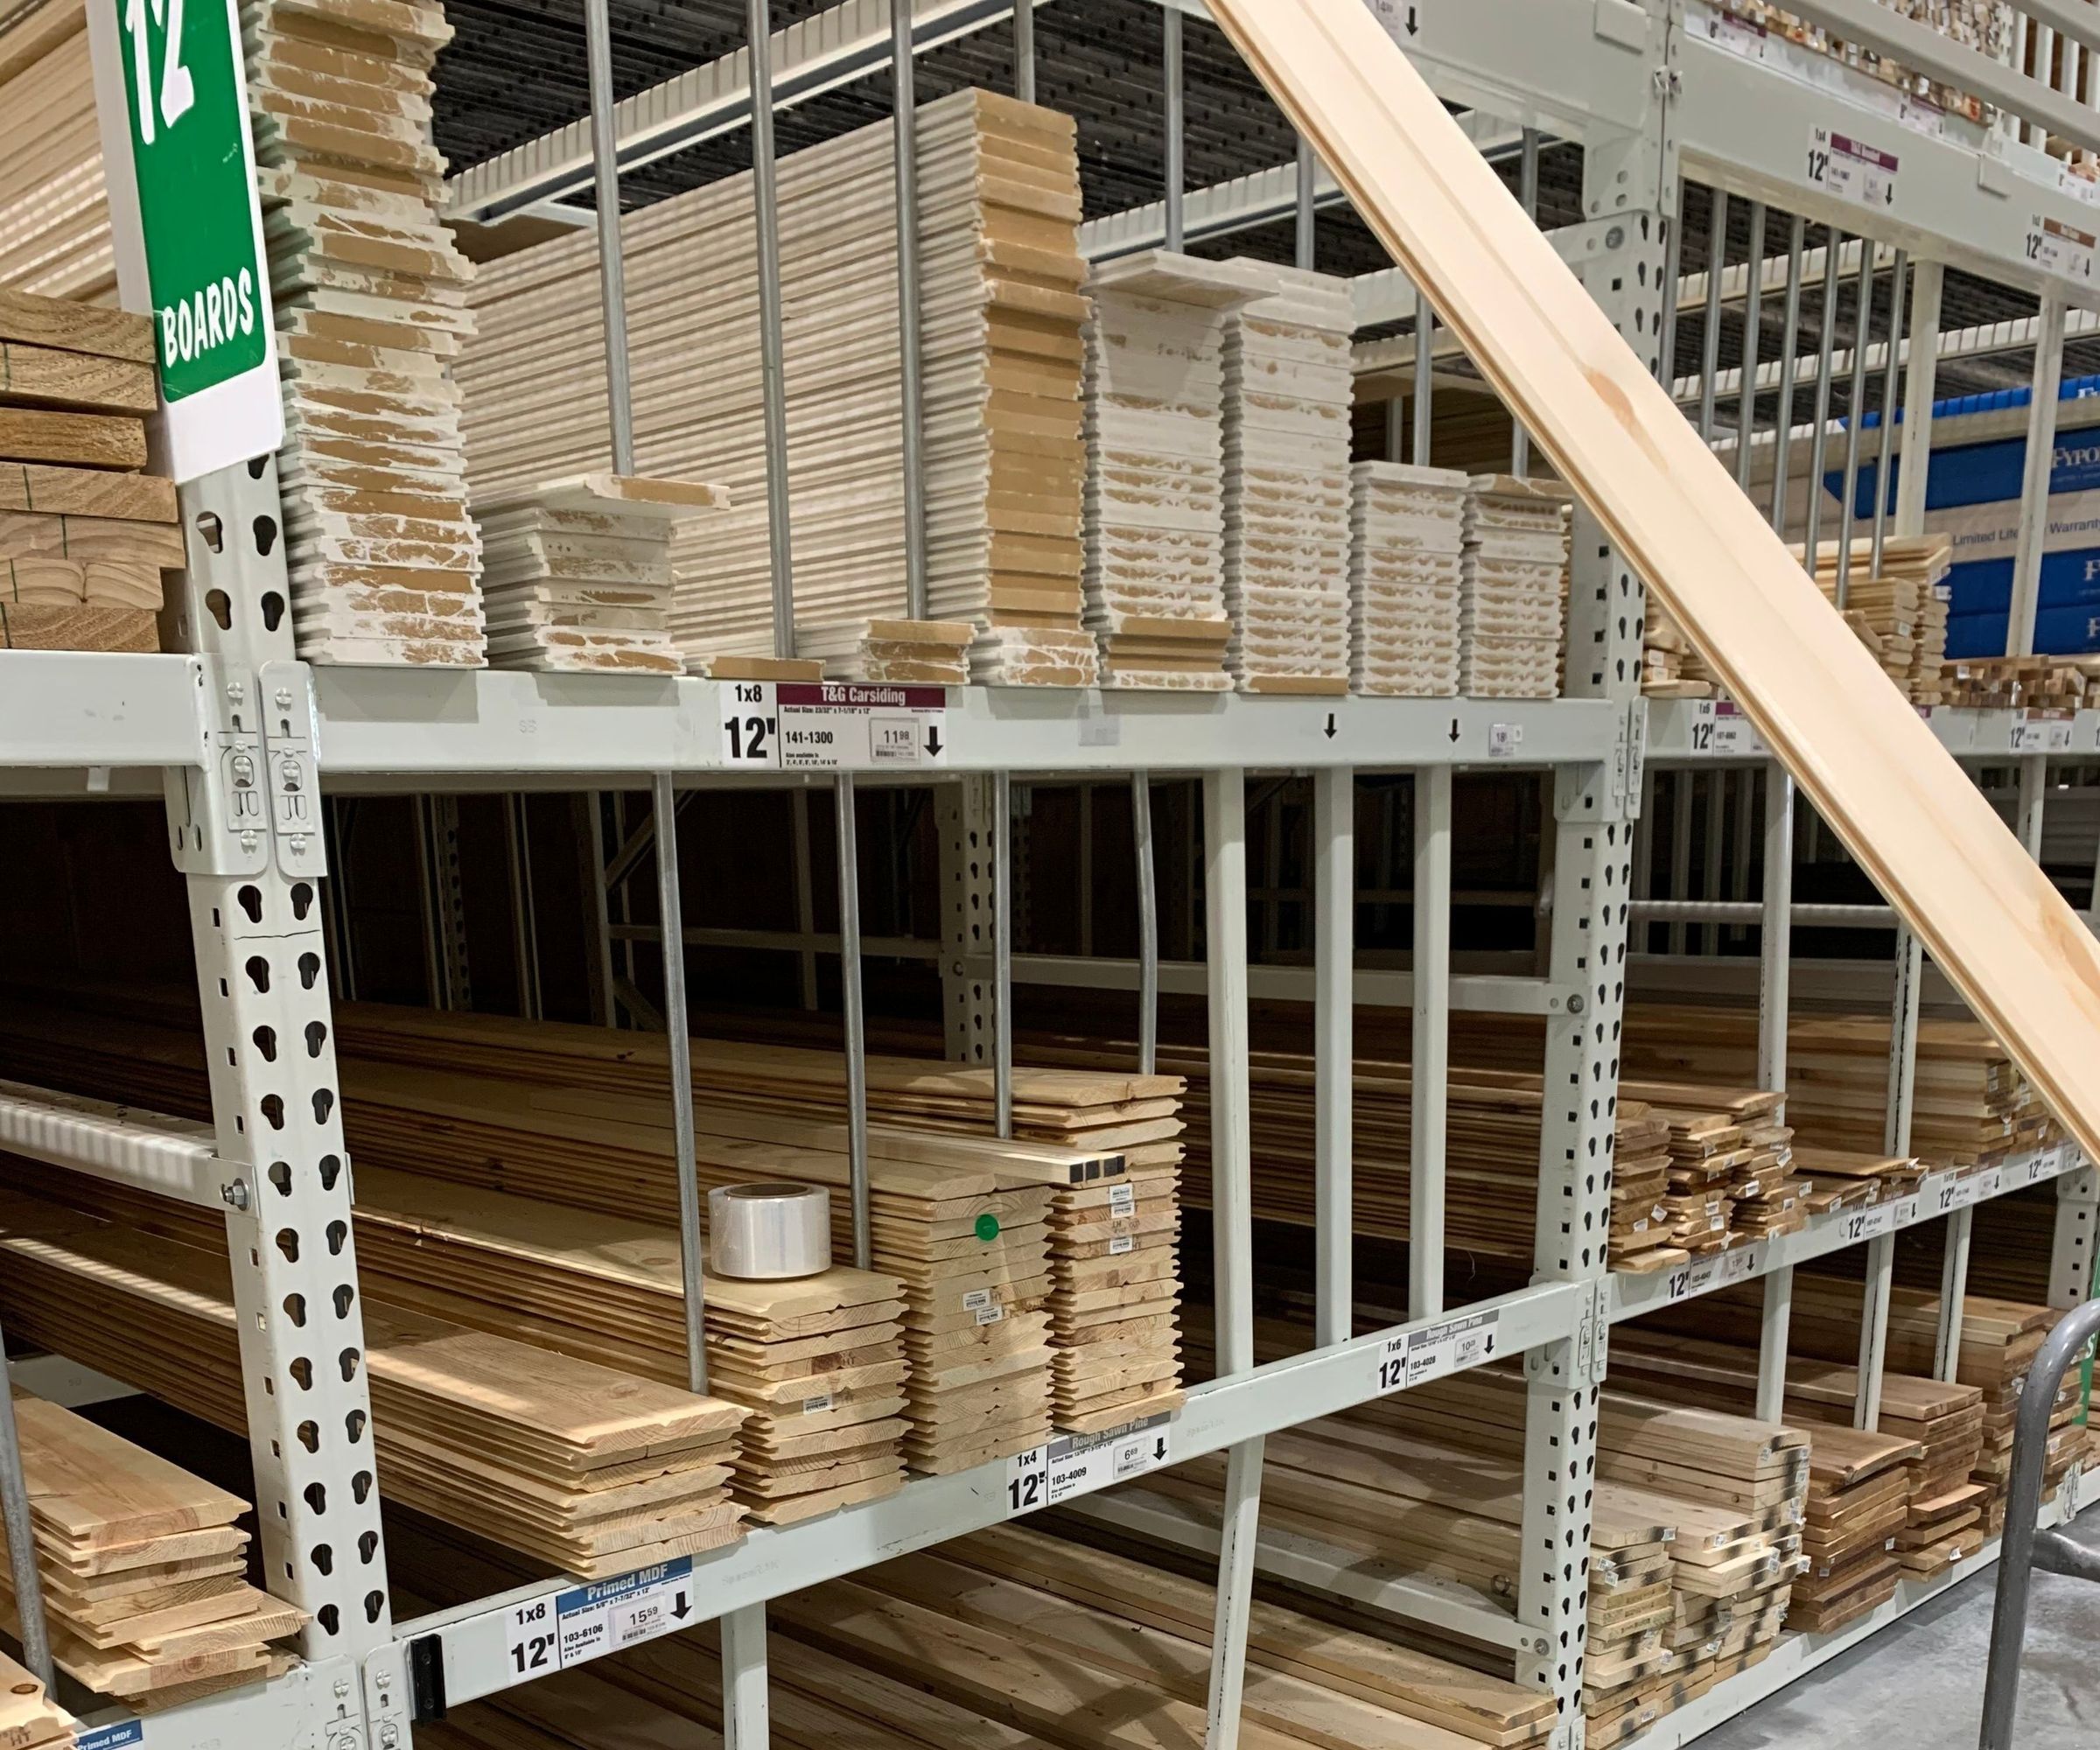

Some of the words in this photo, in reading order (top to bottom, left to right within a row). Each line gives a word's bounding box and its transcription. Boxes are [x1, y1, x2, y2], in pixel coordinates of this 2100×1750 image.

[1809, 149, 1828, 181] 12'
[2026, 232, 2042, 259] 12'
[162, 267, 253, 368] BOARDS
[1953, 531, 1995, 546] Limited
[735, 684, 762, 703] 1x8
[821, 686, 846, 703] T&G
[849, 689, 906, 706] Carsiding
[724, 717, 776, 759] 12'
[785, 731, 834, 744] 141-1300
[1692, 723, 1714, 749] 12'
[1940, 1186, 1954, 1209] 12'
[1849, 1216, 1865, 1239] 12'
[1670, 1271, 1690, 1298] 12'
[1387, 1339, 1402, 1353] 1x6
[1379, 1357, 1406, 1390] 12'
[1072, 1432, 1101, 1449] Rough
[1103, 1425, 1128, 1441] Sawn
[1130, 1418, 1149, 1431] Pine
[1017, 1450, 1037, 1467] 1x4
[1052, 1466, 1087, 1486] 103-4009
[1008, 1470, 1046, 1510] 12'
[587, 1577, 635, 1601] Primed
[639, 1564, 668, 1585] MDF
[515, 1603, 546, 1625] 1x8
[562, 1609, 580, 1620] Actual
[581, 1605, 595, 1614] Size:
[564, 1624, 604, 1644] 103-6106
[511, 1633, 555, 1673] 12'
[77, 1737, 110, 1750] Primed
[112, 1730, 132, 1742] MDF
